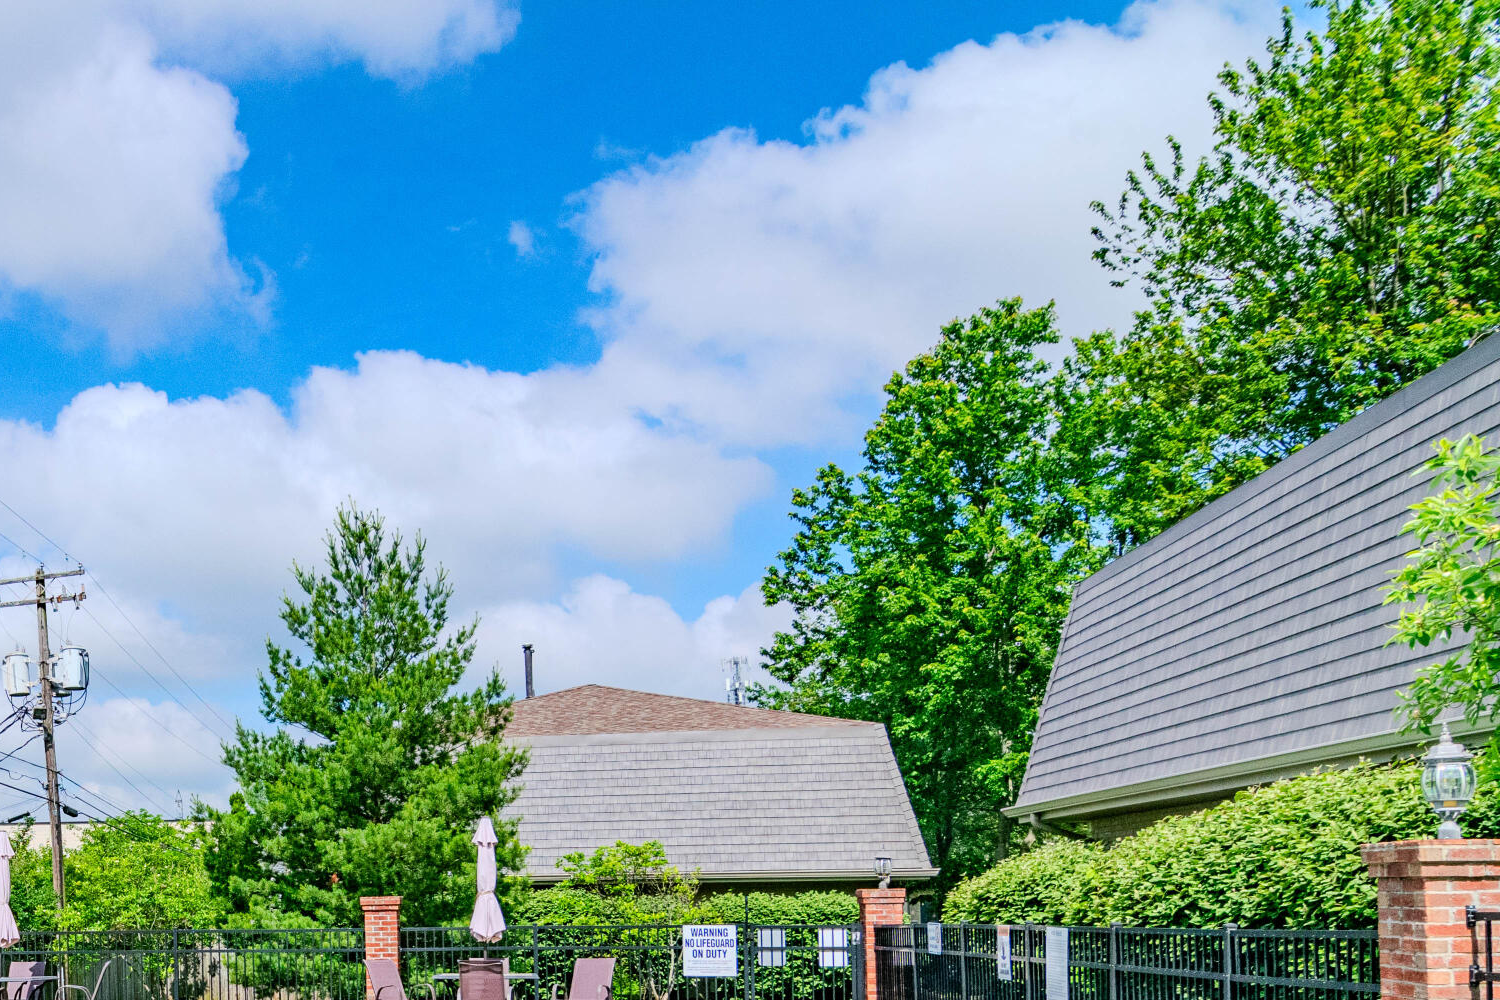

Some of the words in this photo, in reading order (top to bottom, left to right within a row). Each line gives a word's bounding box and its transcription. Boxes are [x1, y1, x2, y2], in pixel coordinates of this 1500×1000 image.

[690, 927, 729, 937] WARNING
[685, 939, 695, 948] NO
[696, 938, 735, 948] LIFEGUARD
[692, 949, 703, 958] ON
[706, 949, 728, 958] DUTY
